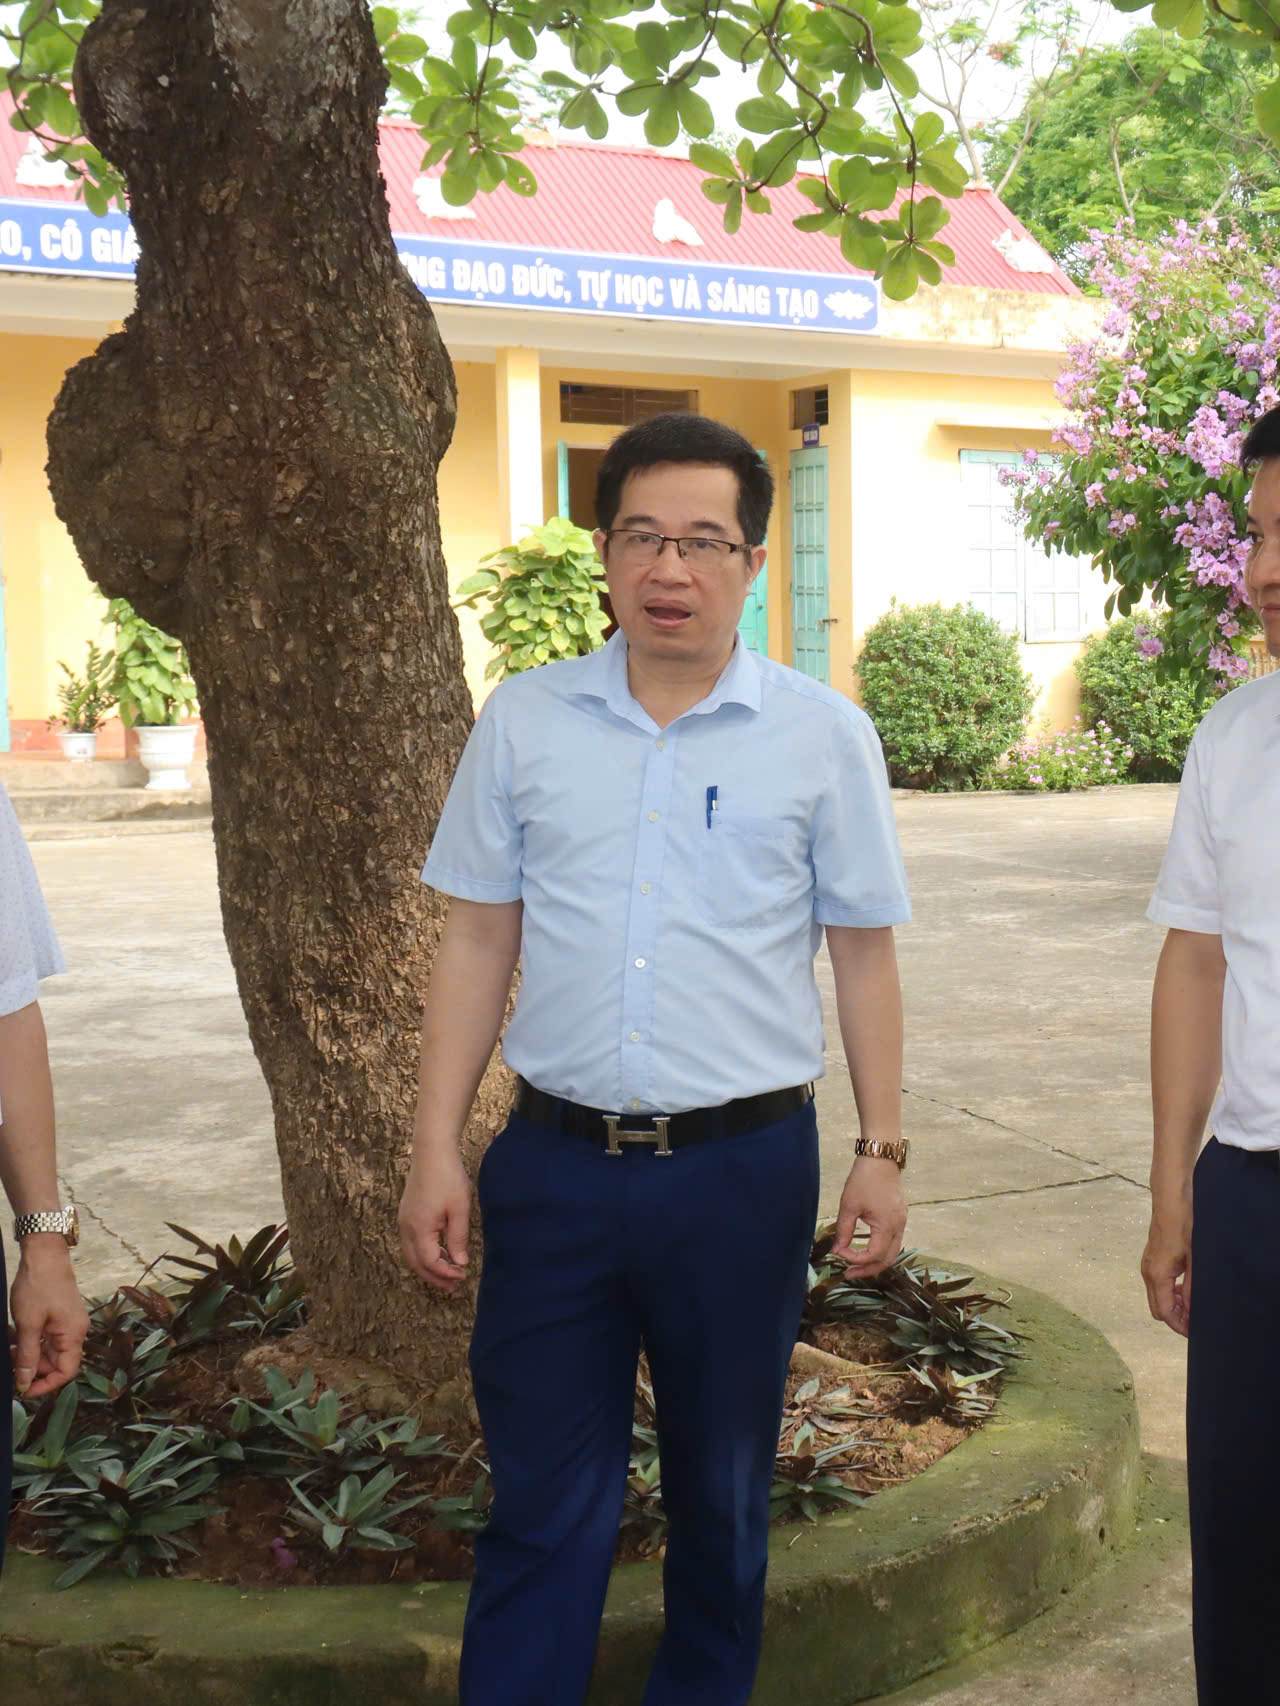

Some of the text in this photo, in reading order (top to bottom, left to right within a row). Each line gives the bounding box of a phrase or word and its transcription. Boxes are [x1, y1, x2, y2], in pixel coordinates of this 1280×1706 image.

[0, 219, 33, 261] O,
[40, 217, 83, 262] CÔ
[398, 251, 447, 289] NG
[452, 258, 506, 300] ĐẠO
[512, 256, 574, 305] ĐỨC,
[577, 270, 613, 309] TỰ
[614, 272, 665, 313] HỌC
[668, 271, 703, 312] VÀ
[705, 276, 772, 316] SÁNG
[774, 285, 820, 325] TẠO
